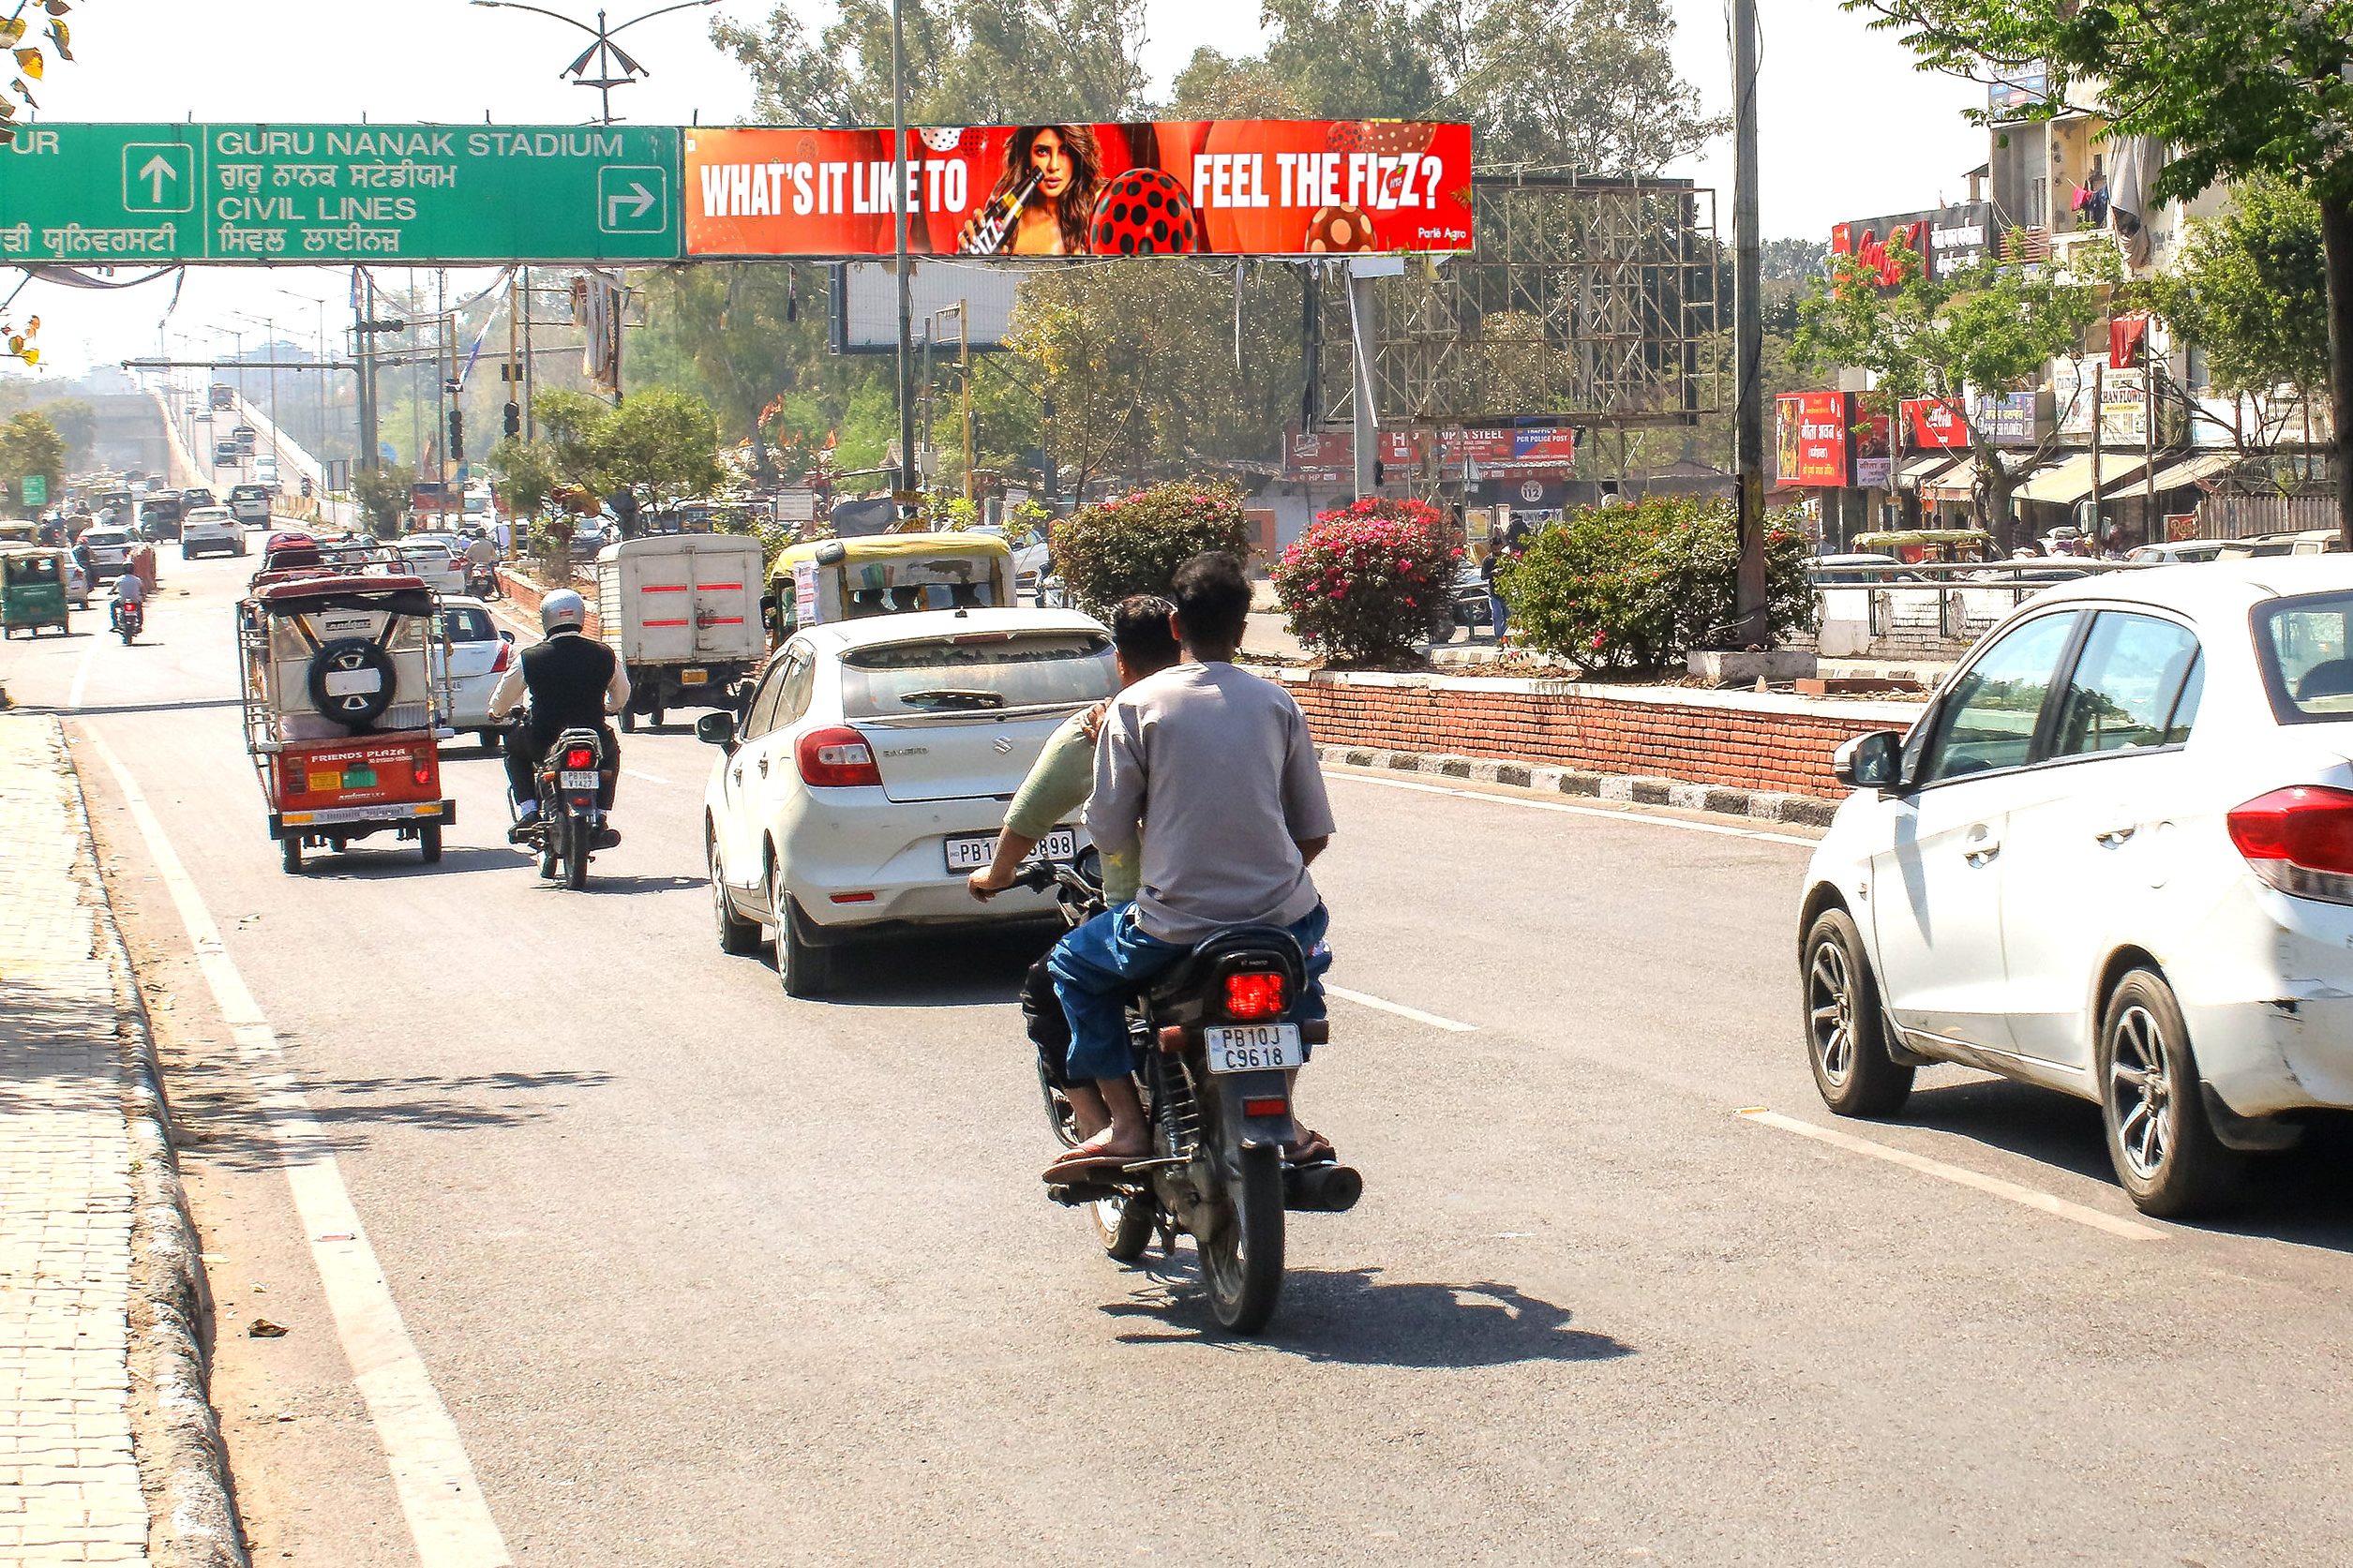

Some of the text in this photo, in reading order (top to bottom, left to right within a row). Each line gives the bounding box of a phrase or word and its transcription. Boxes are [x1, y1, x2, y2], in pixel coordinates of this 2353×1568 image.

[217, 131, 624, 157] GURU NANAK STADIUM
[217, 164, 264, 193] ਗੁਰੂ
[272, 164, 339, 187] ਨਾਨਕ
[700, 158, 967, 217] WHAT'S IT LIKE TO
[1192, 153, 1270, 209] FEEL
[1276, 152, 1341, 207] THE
[217, 197, 418, 220] CIVIL LINES
[217, 221, 288, 252] ਸਿਵਲ
[1444, 227, 1467, 241] Agro
[1523, 488, 1540, 498] 112
[311, 752, 364, 763] FRIENDS
[367, 747, 407, 758] PLAZA
[1221, 1027, 1281, 1048] PB10J
[1225, 1048, 1283, 1068] C9618
